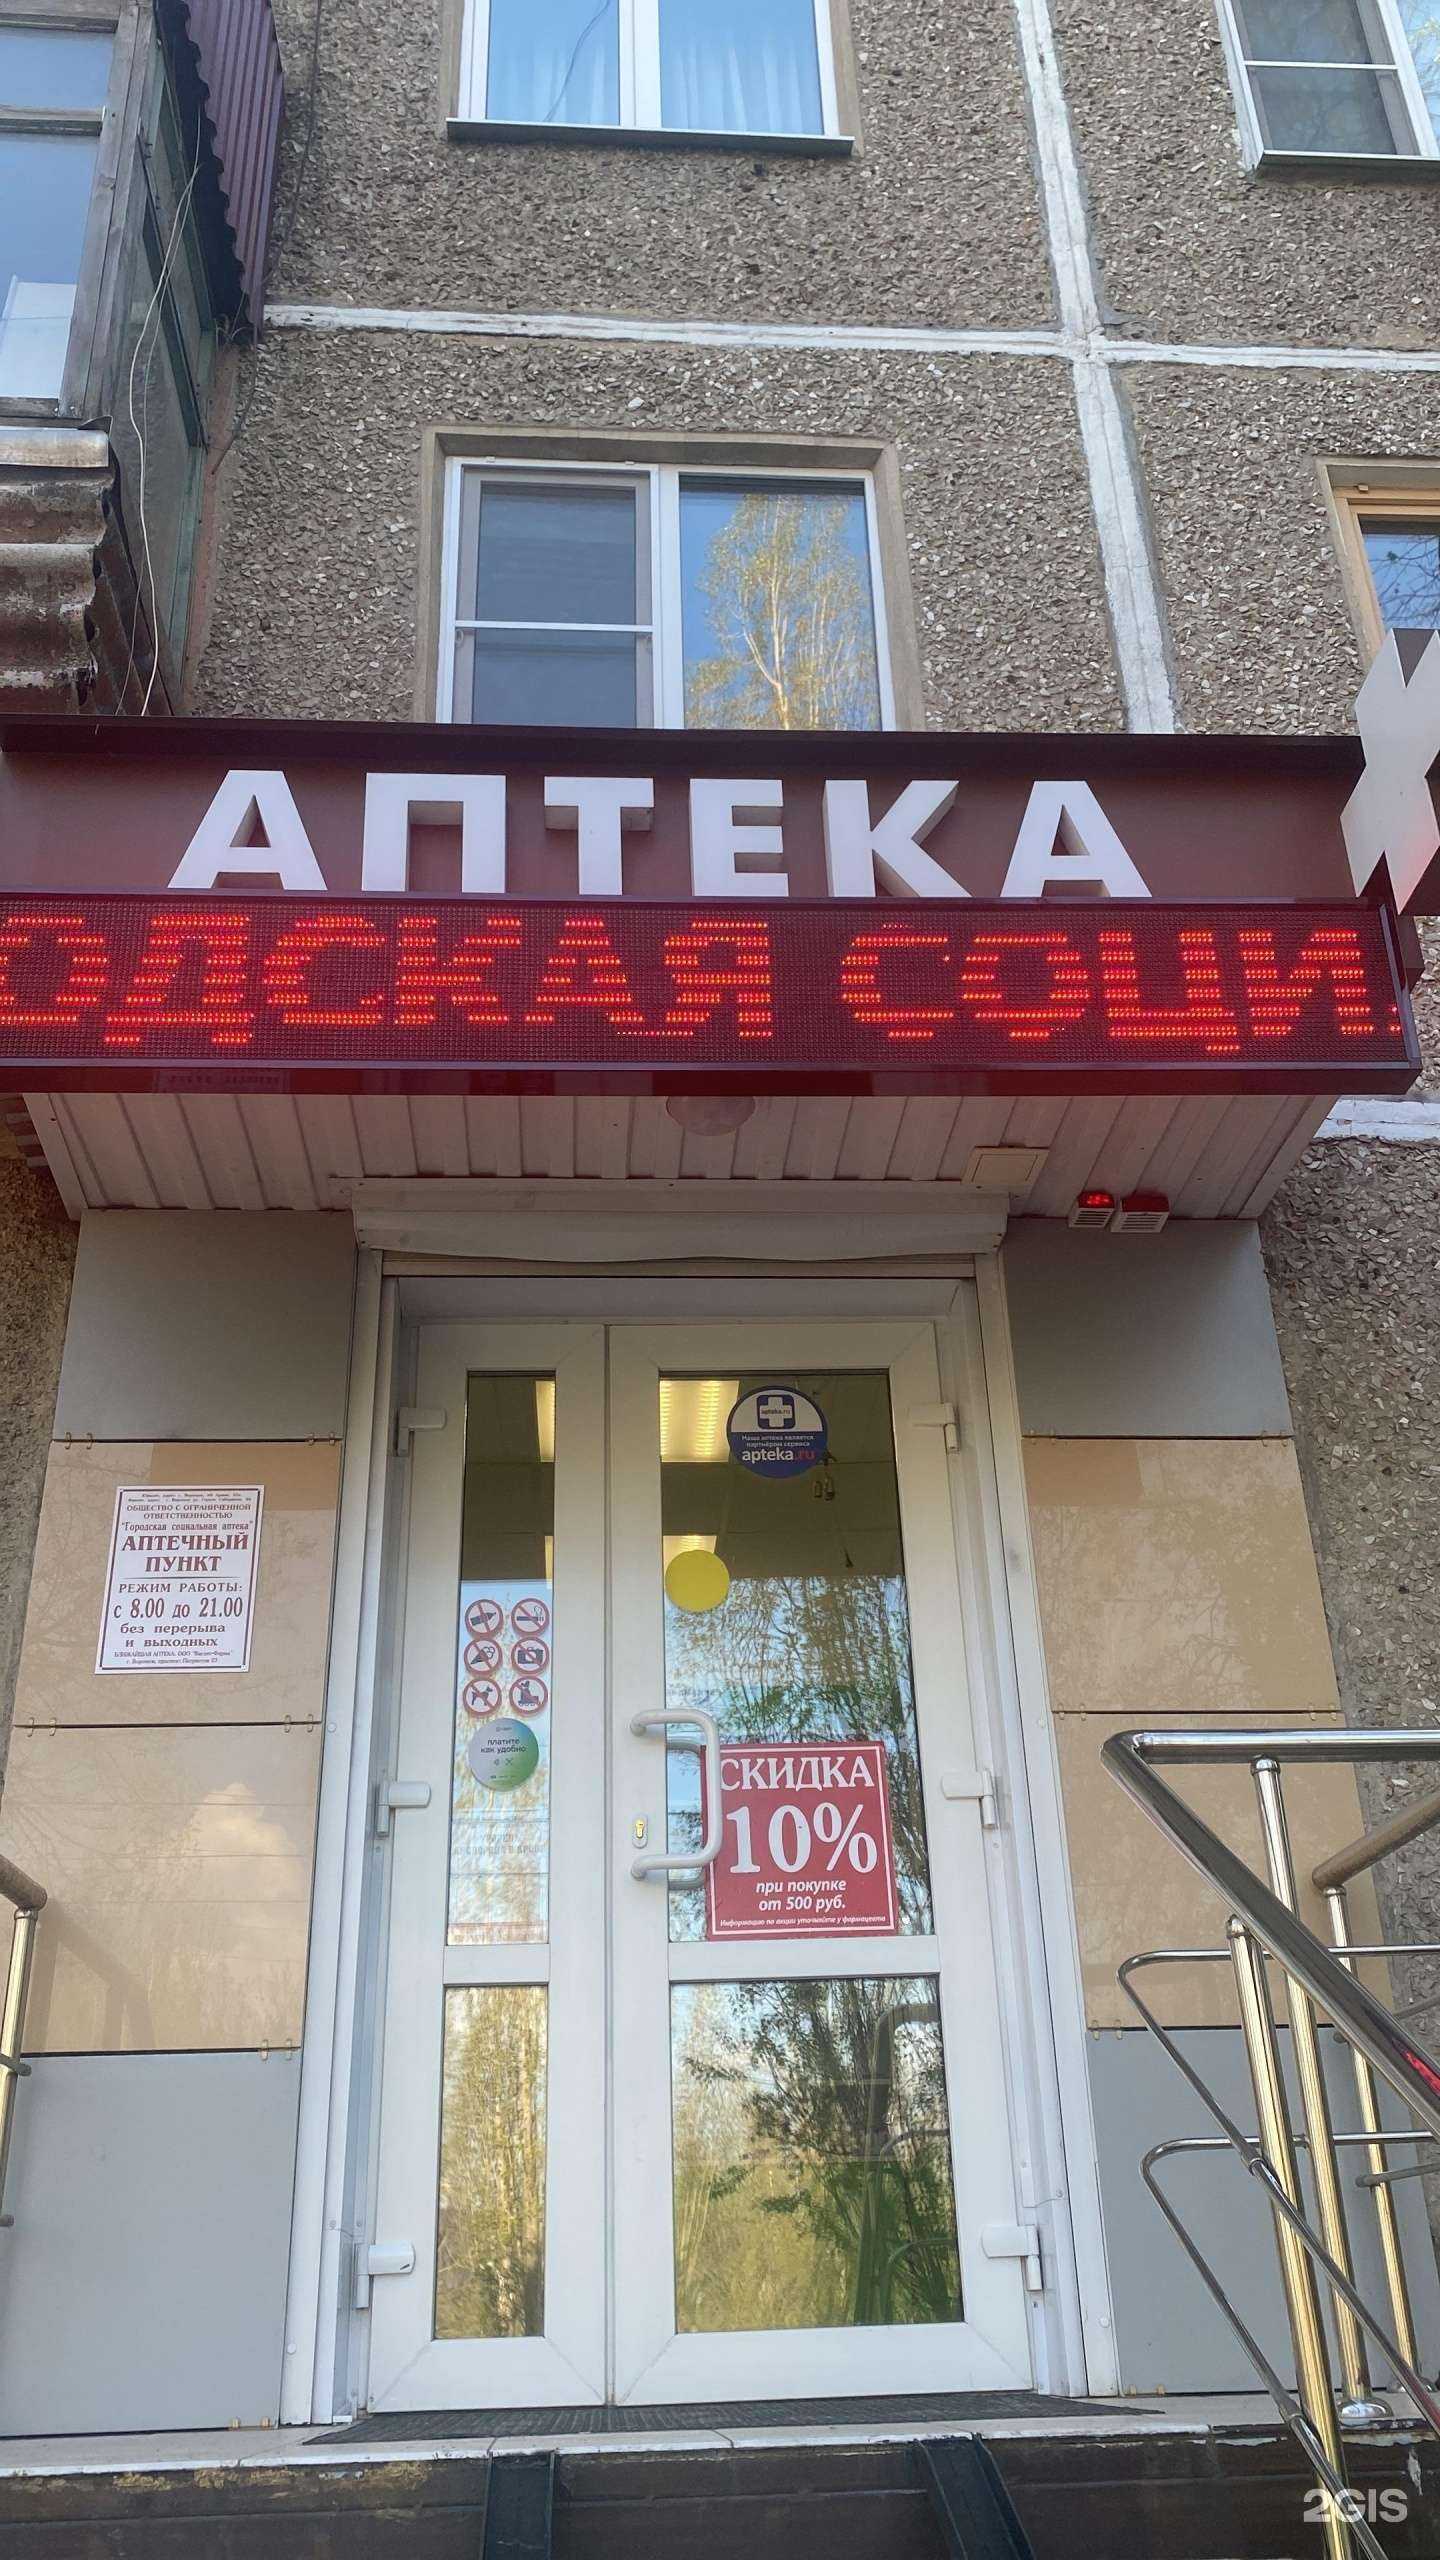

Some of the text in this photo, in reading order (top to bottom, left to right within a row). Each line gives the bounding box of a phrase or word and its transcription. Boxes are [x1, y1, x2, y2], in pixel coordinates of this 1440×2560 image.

[168, 769, 1153, 898] АПТЕКА
[742, 1447, 815, 1464] apteka.ru
[126, 1504, 173, 1512] ОБЩЕСТВО
[121, 1531, 249, 1551] АПТЕЧНЫЙ
[145, 1556, 222, 1572] ПУНКТ
[119, 1582, 243, 1593] РЕЖИМ РАБОТЫ:
[113, 1596, 243, 1619] с 8.00 до 21.00
[120, 1622, 226, 1635] без перерыва
[125, 1638, 218, 1648] и выходных
[720, 1755, 875, 1792] СКИДКА
[726, 1802, 878, 1874] 10%
[755, 1879, 846, 1896] при покупке
[758, 1894, 846, 1912] от 500 руб.
